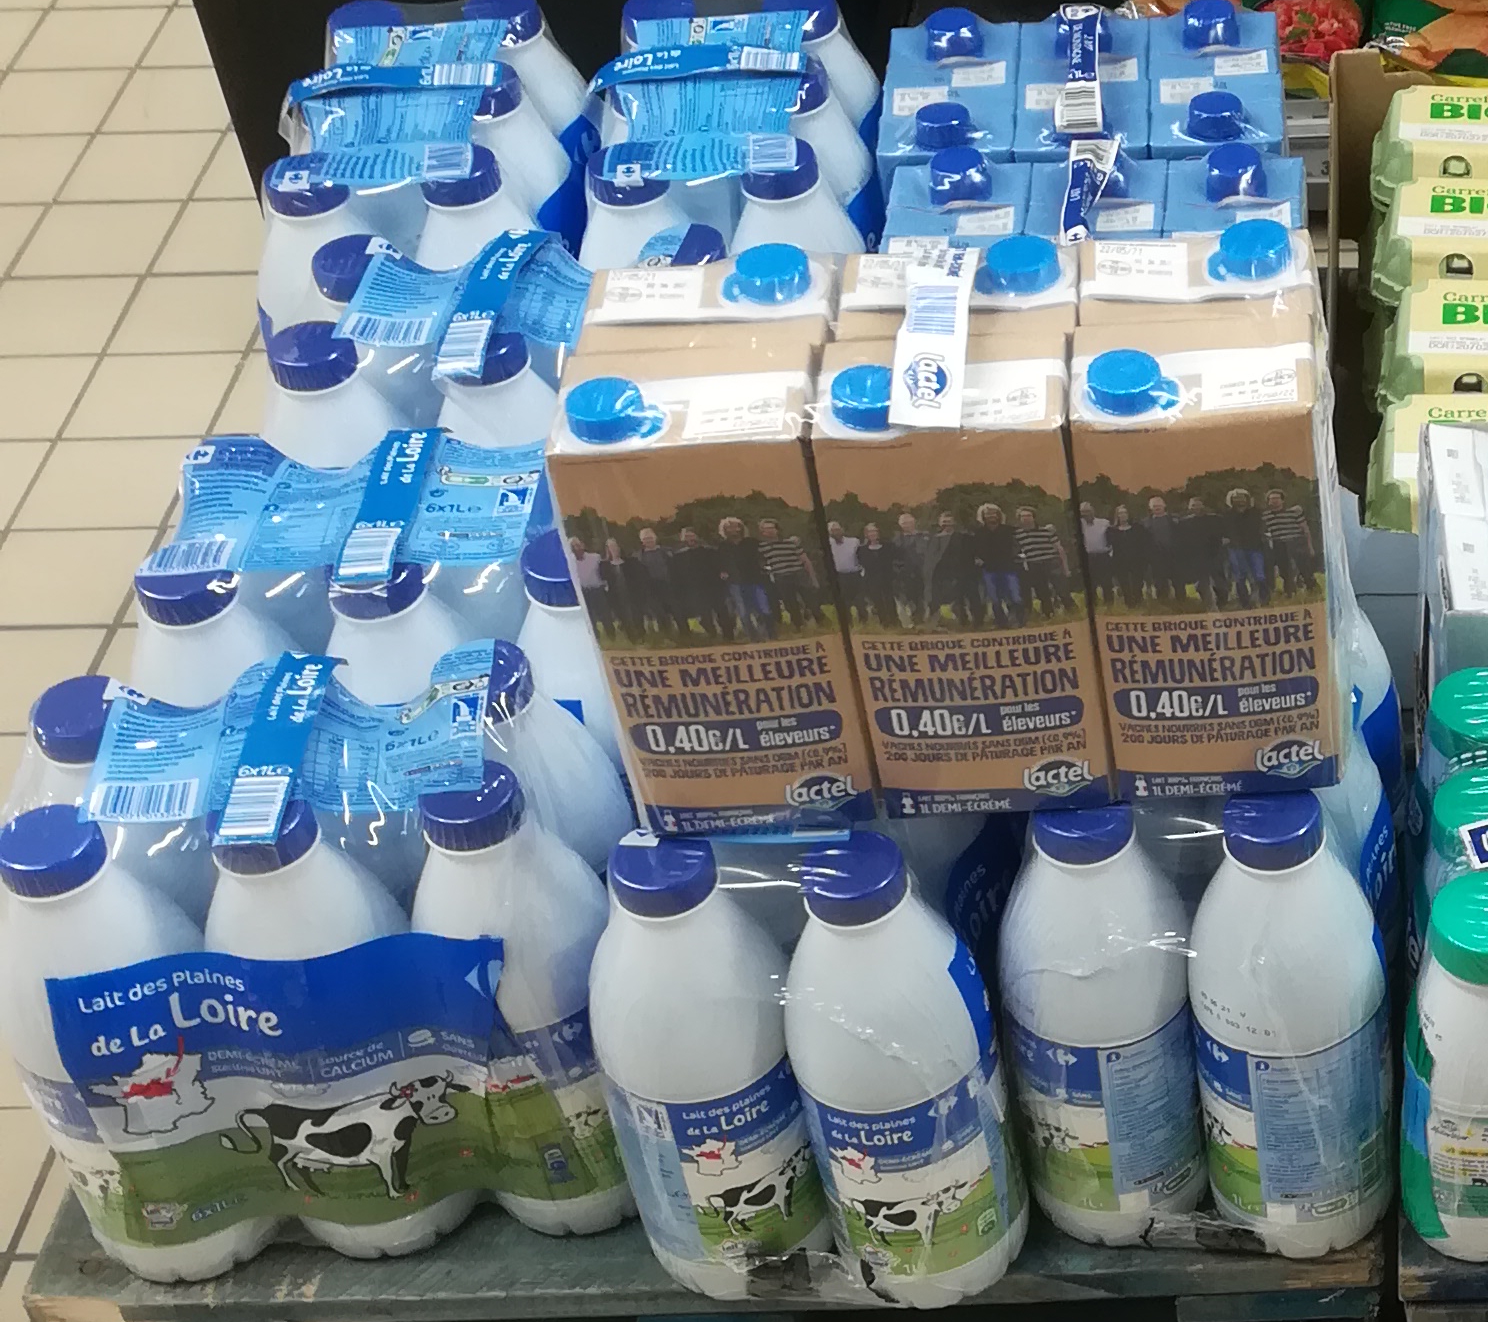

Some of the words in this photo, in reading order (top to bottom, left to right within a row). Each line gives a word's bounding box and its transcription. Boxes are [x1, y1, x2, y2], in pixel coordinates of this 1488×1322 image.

[614, 53, 653, 71] Loire
[903, 352, 952, 410] lactel
[396, 432, 427, 462] Loire
[1105, 621, 1149, 633] CETTE
[1152, 619, 1208, 633] BRIQUE
[1212, 612, 1299, 629] CONTRIBUE
[862, 640, 904, 651] CETTE
[908, 638, 966, 651] BRIQUE
[970, 631, 1058, 649] CONTRIBUE
[1106, 634, 1163, 654] UNE
[1170, 622, 1315, 654] MEILLEURE
[610, 655, 656, 667] CETTE
[658, 652, 717, 666] BRIQUE
[721, 644, 810, 664] CONTRIBUE
[864, 652, 921, 673] UNE
[928, 642, 1077, 673] MEILLEURE
[1110, 646, 1316, 684] RÉMUNÉRATION
[286, 663, 323, 697] Loire
[613, 668, 673, 689] UNE
[679, 655, 831, 688] MEILLEURE
[869, 666, 1079, 703] RÉMUNÉRATION
[621, 680, 837, 720] RÉMUNÉRATION
[1237, 685, 1260, 696] pour
[1261, 683, 1276, 693] les
[781, 715, 797, 727] les
[1000, 705, 1022, 715] pour
[1024, 702, 1040, 712] les
[1121, 732, 1145, 743] 200
[1147, 733, 1188, 745] JOURS
[1207, 727, 1271, 744] PÂTURAGE
[1274, 723, 1297, 736] PAR
[1300, 721, 1319, 731] AN
[827, 754, 848, 766] AN
[911, 750, 952, 762] JOURS
[1067, 741, 1087, 752] AN
[1255, 740, 1324, 772] lactel
[1023, 760, 1095, 791] lactel
[1152, 786, 1163, 797] 1L
[1165, 781, 1242, 795] DEMI-ÉCRÉMÉ
[785, 776, 859, 806] lactel
[77, 987, 123, 1015] Lait
[128, 979, 168, 1003] des
[171, 969, 246, 993] Plaines
[90, 1036, 123, 1059] de
[130, 1021, 166, 1049] La
[168, 993, 284, 1039] Loire
[320, 1048, 395, 1078] CALCIUM
[682, 1109, 704, 1121] Lait
[706, 1104, 731, 1117] des
[732, 1084, 772, 1114] plaines
[720, 1099, 771, 1132] Loire
[848, 1118, 868, 1130] des
[871, 1115, 916, 1131] plaines
[860, 1127, 914, 1147] Loire
